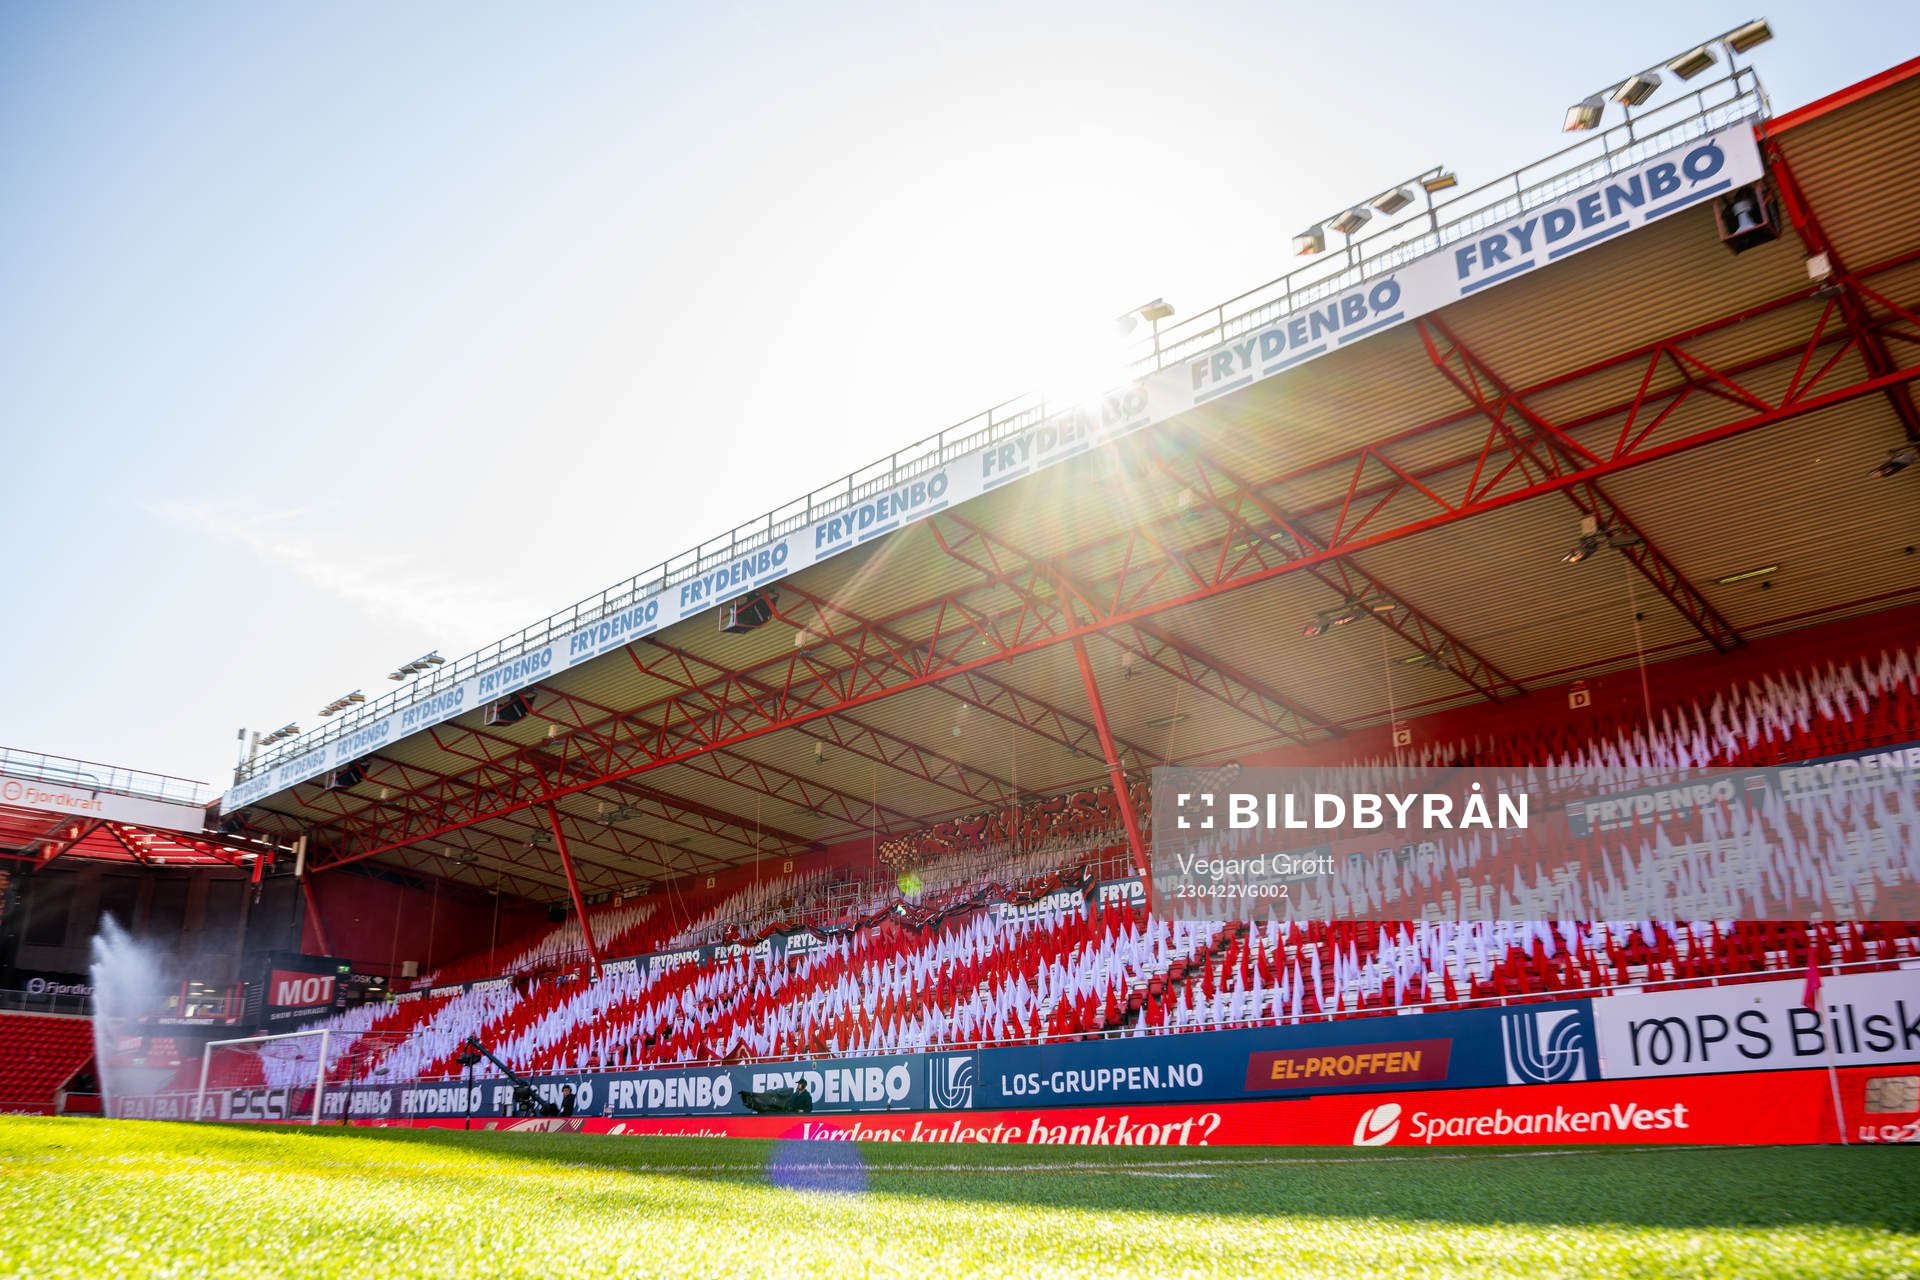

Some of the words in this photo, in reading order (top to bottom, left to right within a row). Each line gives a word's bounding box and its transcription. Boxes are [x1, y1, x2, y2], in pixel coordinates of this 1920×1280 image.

[1455, 139, 1724, 280] FRYDENBØ
[1190, 275, 1401, 390] FRYDENBØ
[815, 467, 948, 549] FRYDENBØ
[680, 538, 788, 608] FRYDENBØ
[570, 597, 658, 656] FRYDENBØ
[478, 646, 553, 695] FRYDENBØ
[401, 685, 465, 729] FRYDENBØ
[335, 719, 390, 758] FRYDENBØ
[25, 787, 103, 811] Fjordkraft
[1585, 777, 1736, 824] FRYDENBØ
[45, 981, 95, 996] Fjordkr
[277, 976, 336, 1006] MOT
[1001, 1062, 1203, 1096] LOS-GRUPPEN.NO
[1271, 1050, 1422, 1080] EL-PROFFEN
[400, 1084, 482, 1114] FRYDENBØ
[608, 1072, 733, 1109] FRYDENBØ
[802, 1122, 906, 1142] Verdens
[911, 1120, 1021, 1143] kuleste
[1027, 1112, 1221, 1146] bankkort?
[1409, 1102, 1690, 1145] SparebankenVest
